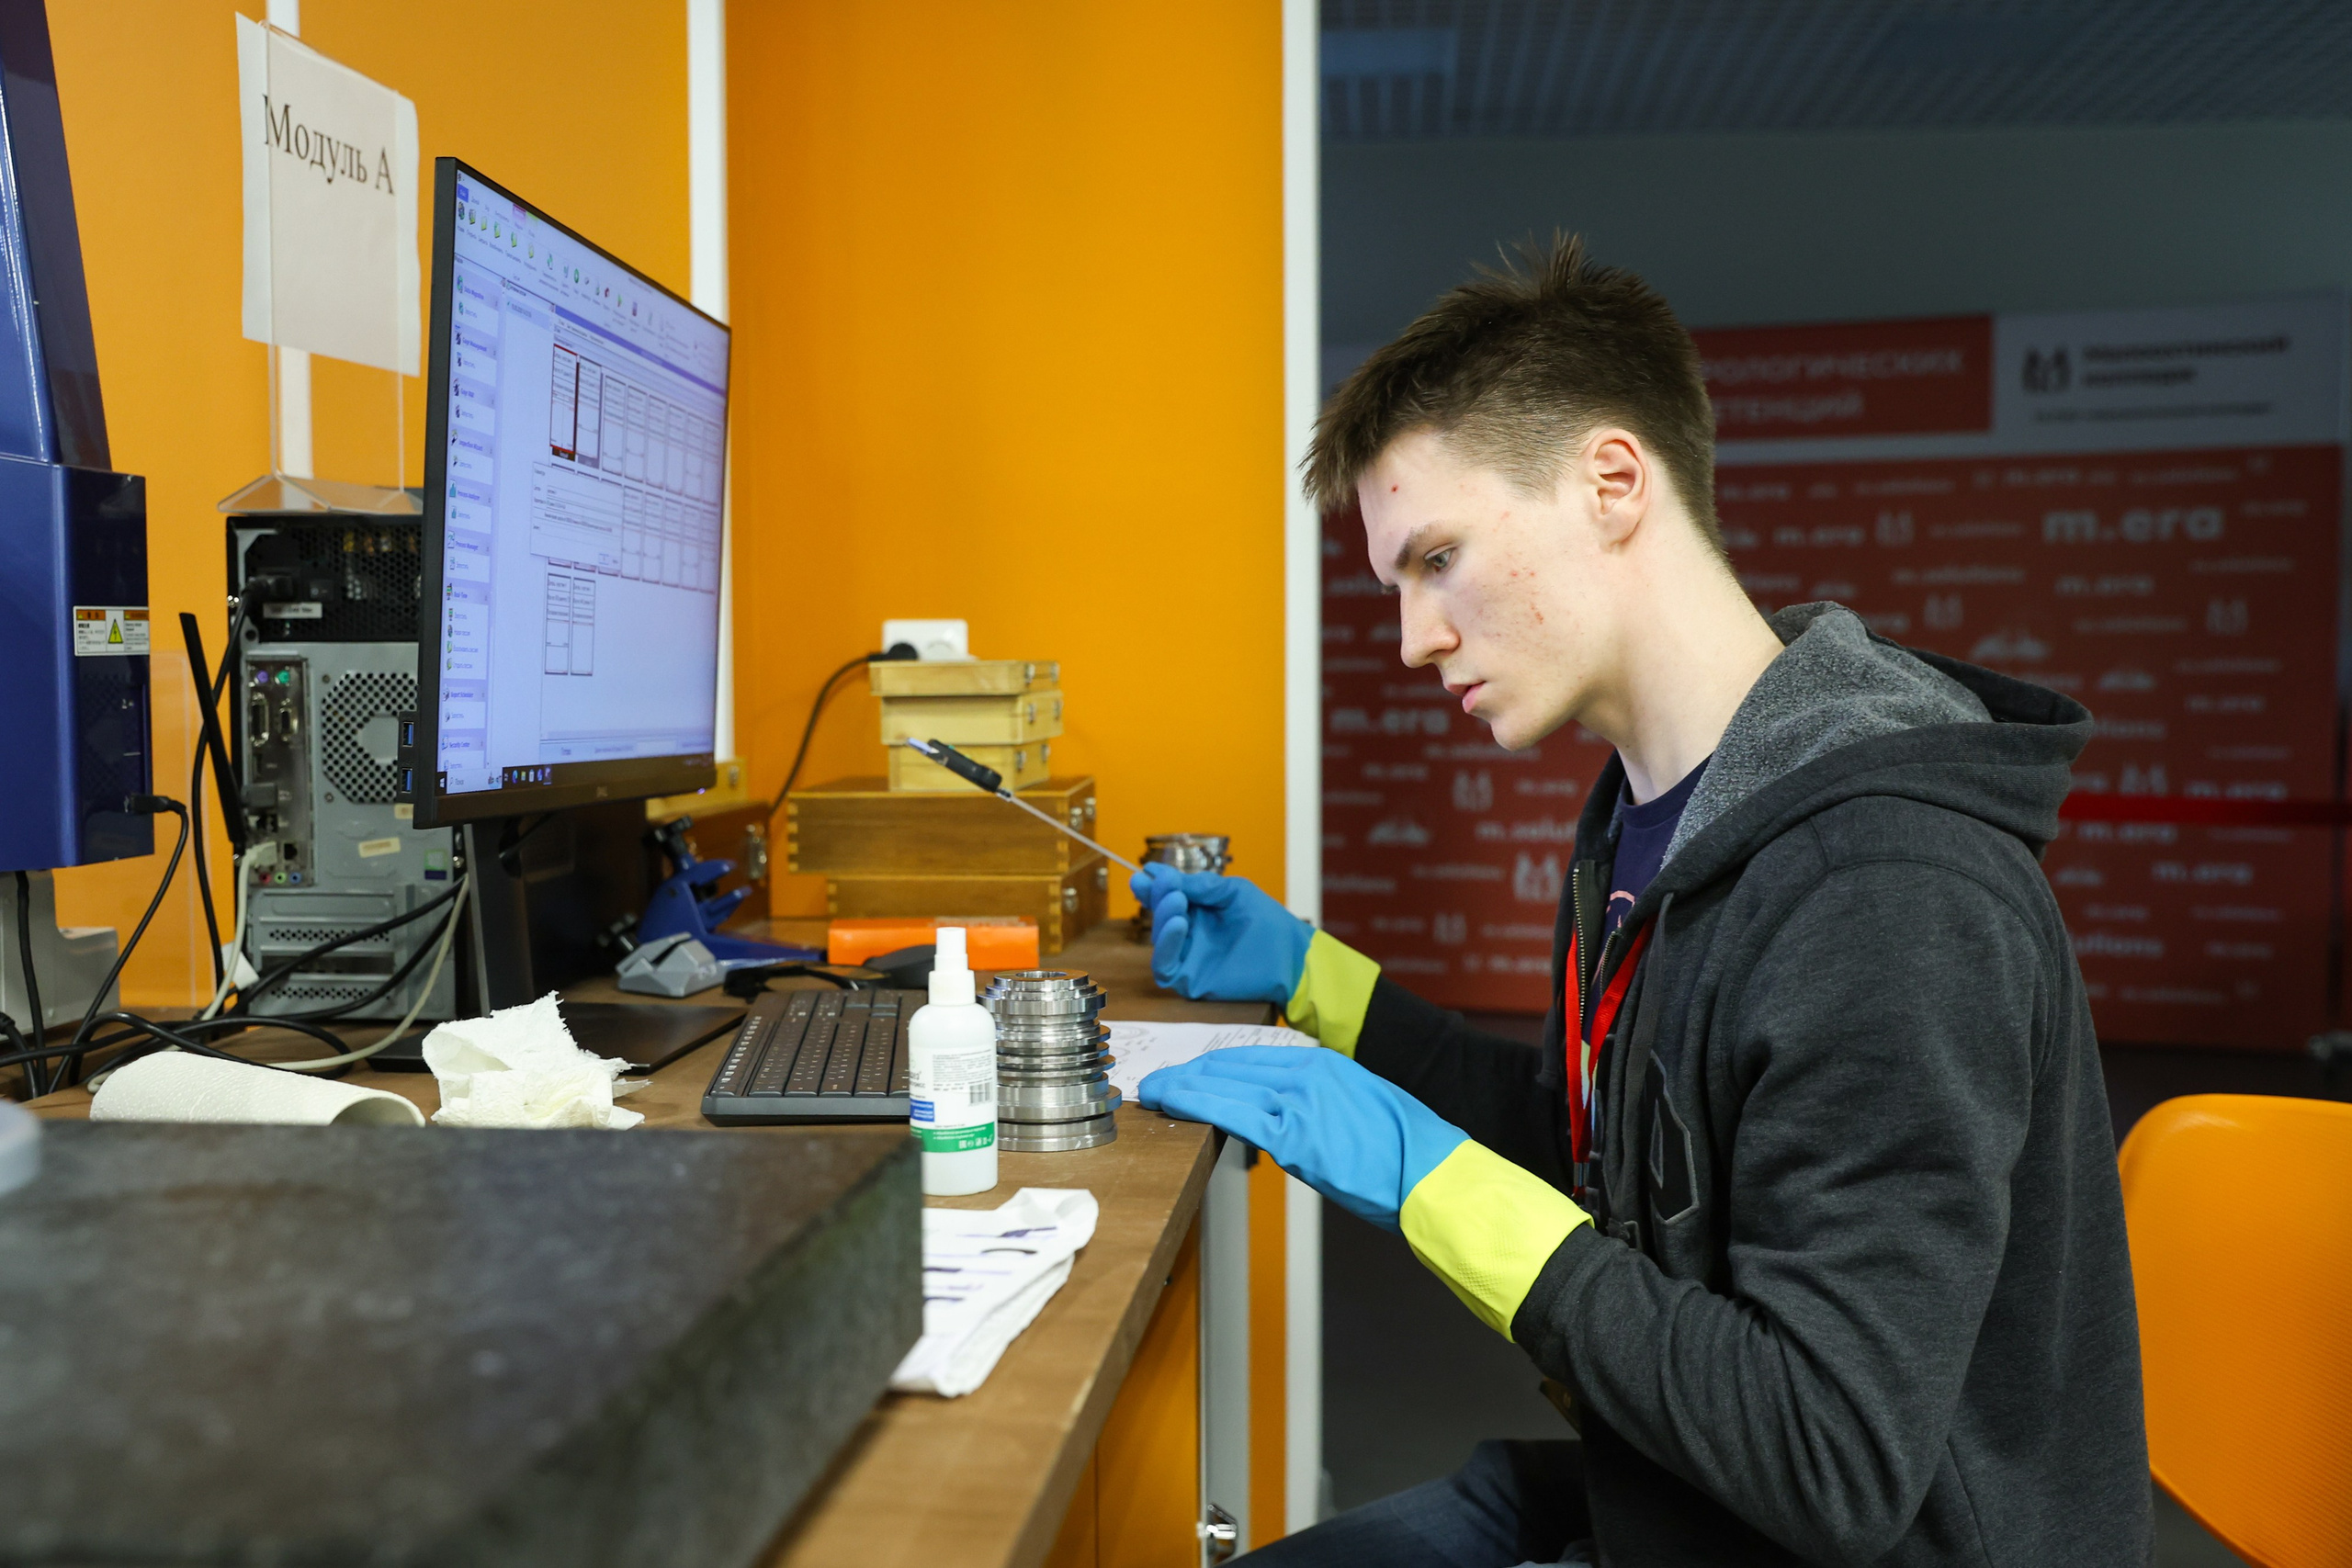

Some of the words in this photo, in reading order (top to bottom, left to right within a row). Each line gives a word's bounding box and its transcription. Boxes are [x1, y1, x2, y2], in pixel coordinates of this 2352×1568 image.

[262, 94, 368, 185] Модуль
[375, 146, 395, 195] А
[2044, 510, 2222, 543] m.era
[1331, 709, 1448, 735] m.era
